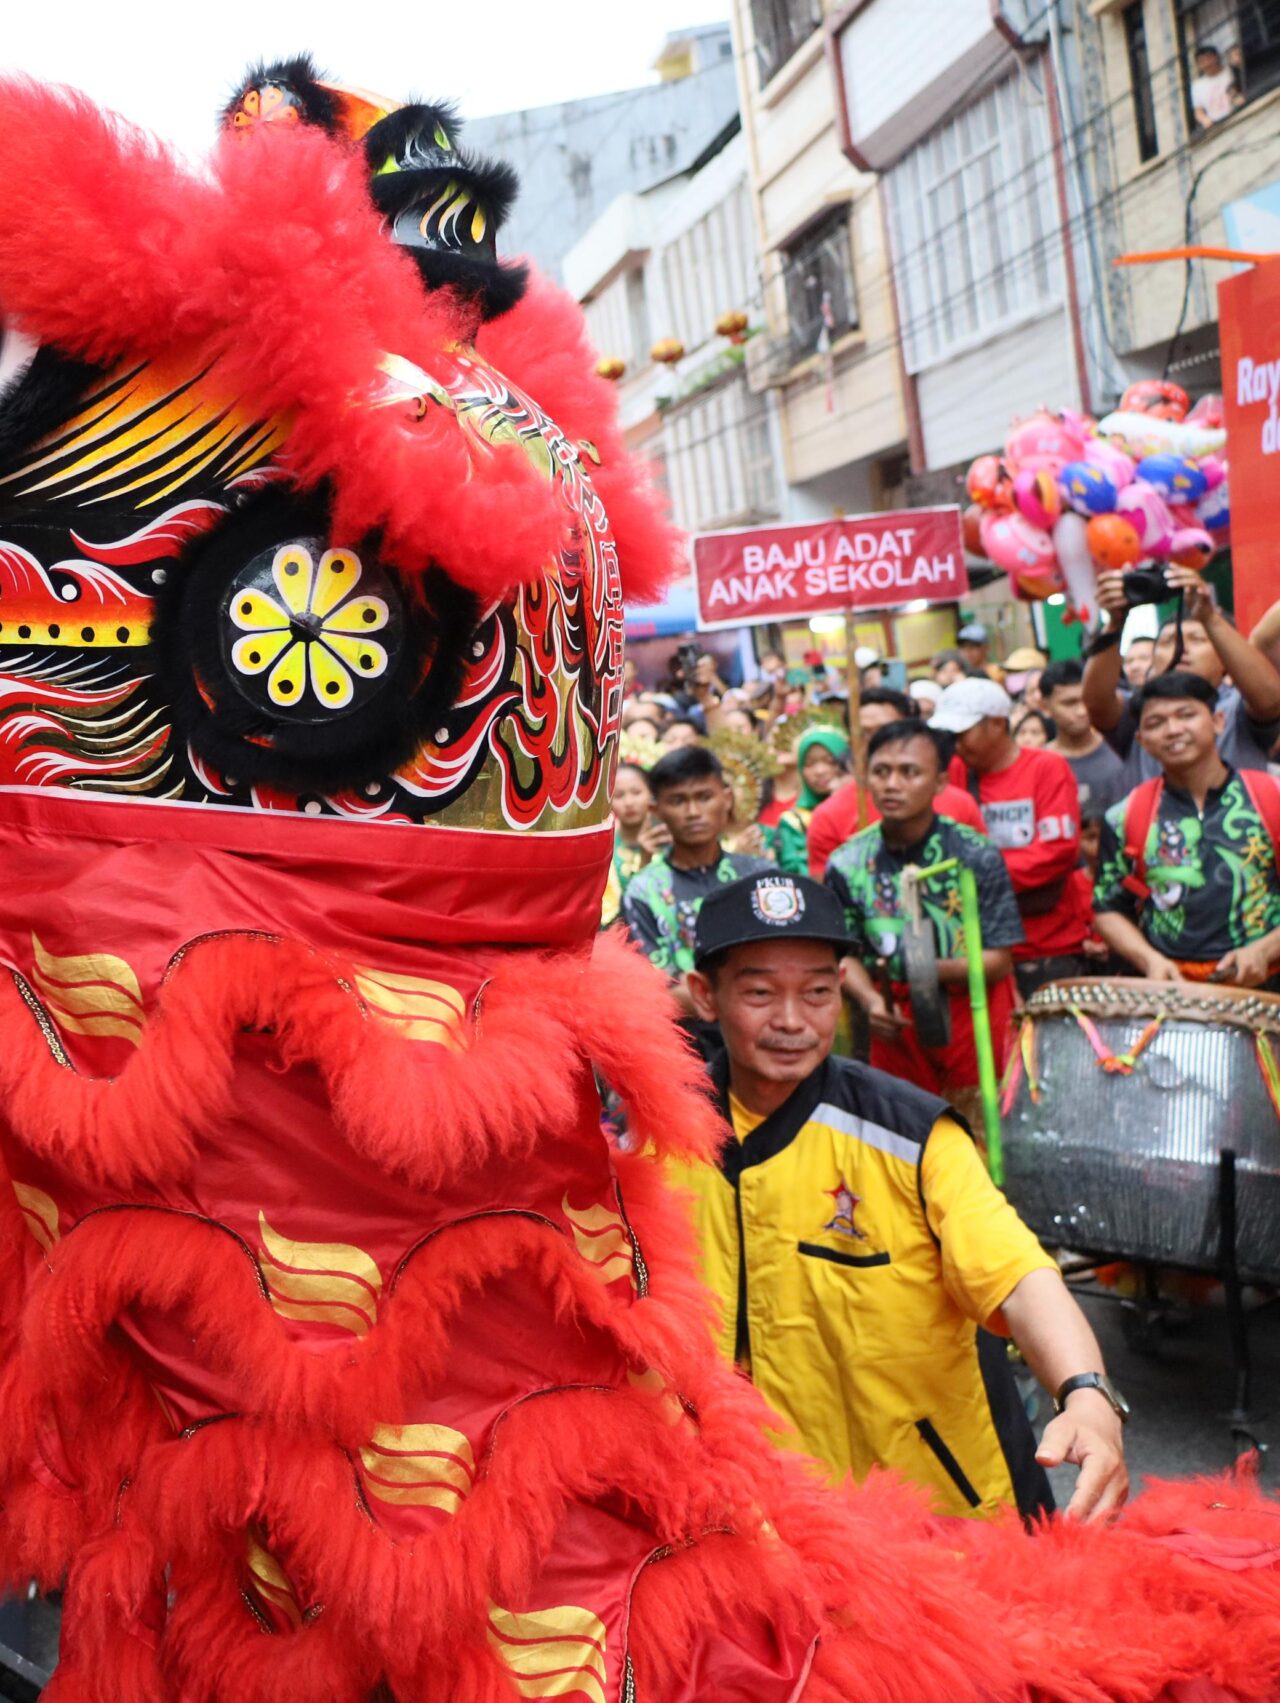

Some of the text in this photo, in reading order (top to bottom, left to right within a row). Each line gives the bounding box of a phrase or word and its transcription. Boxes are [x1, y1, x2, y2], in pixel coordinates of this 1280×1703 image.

[742, 528, 916, 574] BAJU ADAT
[707, 553, 956, 608] ANAK SEKOLAH
